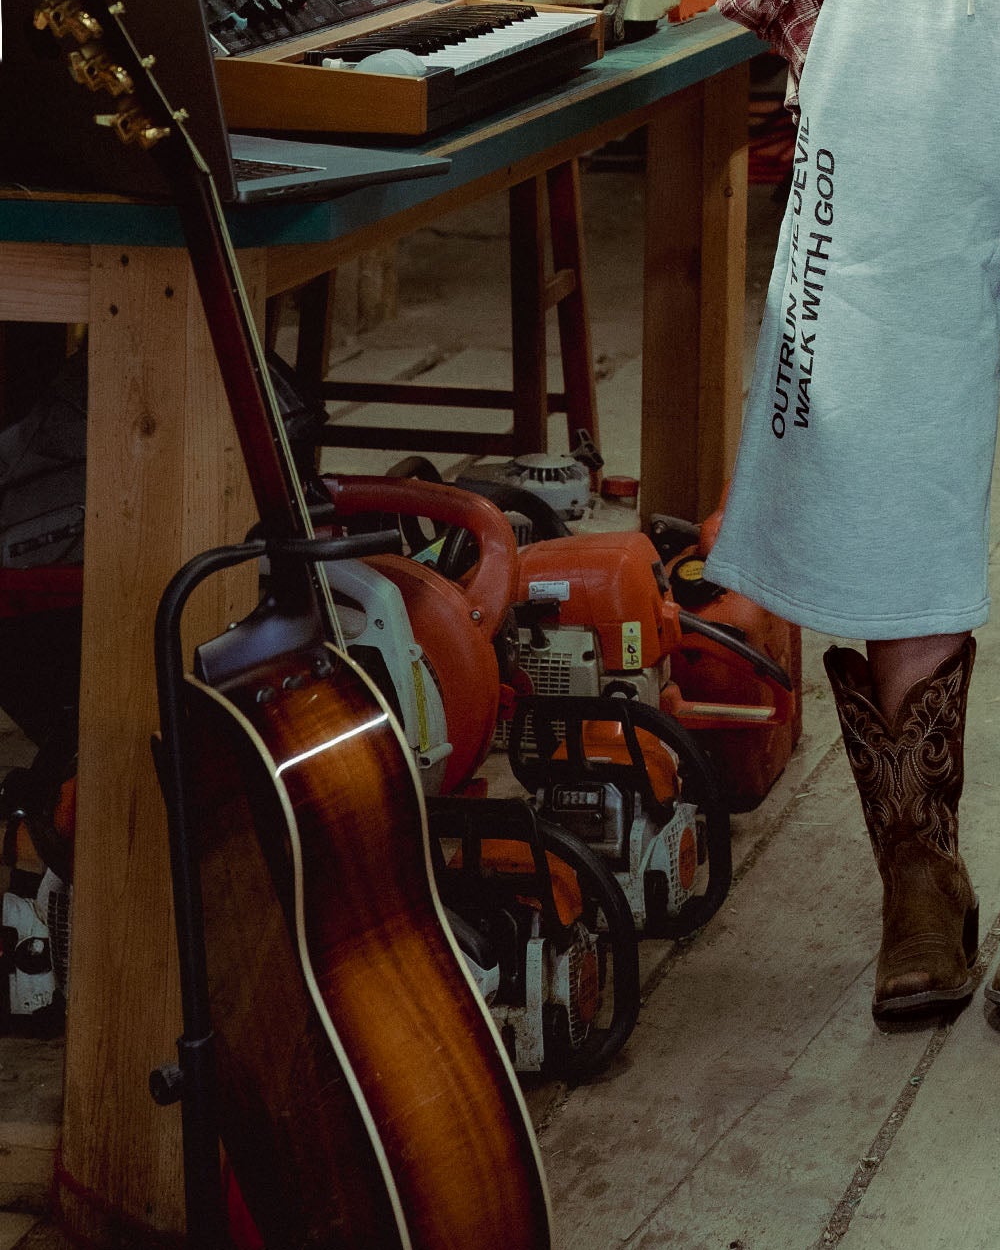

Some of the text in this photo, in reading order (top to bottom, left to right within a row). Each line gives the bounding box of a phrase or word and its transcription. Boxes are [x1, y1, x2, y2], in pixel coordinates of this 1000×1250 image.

[771, 292, 797, 440] OUTRUN
[793, 116, 810, 216] DEVIL
[793, 148, 835, 429] WALK WITH GOD
